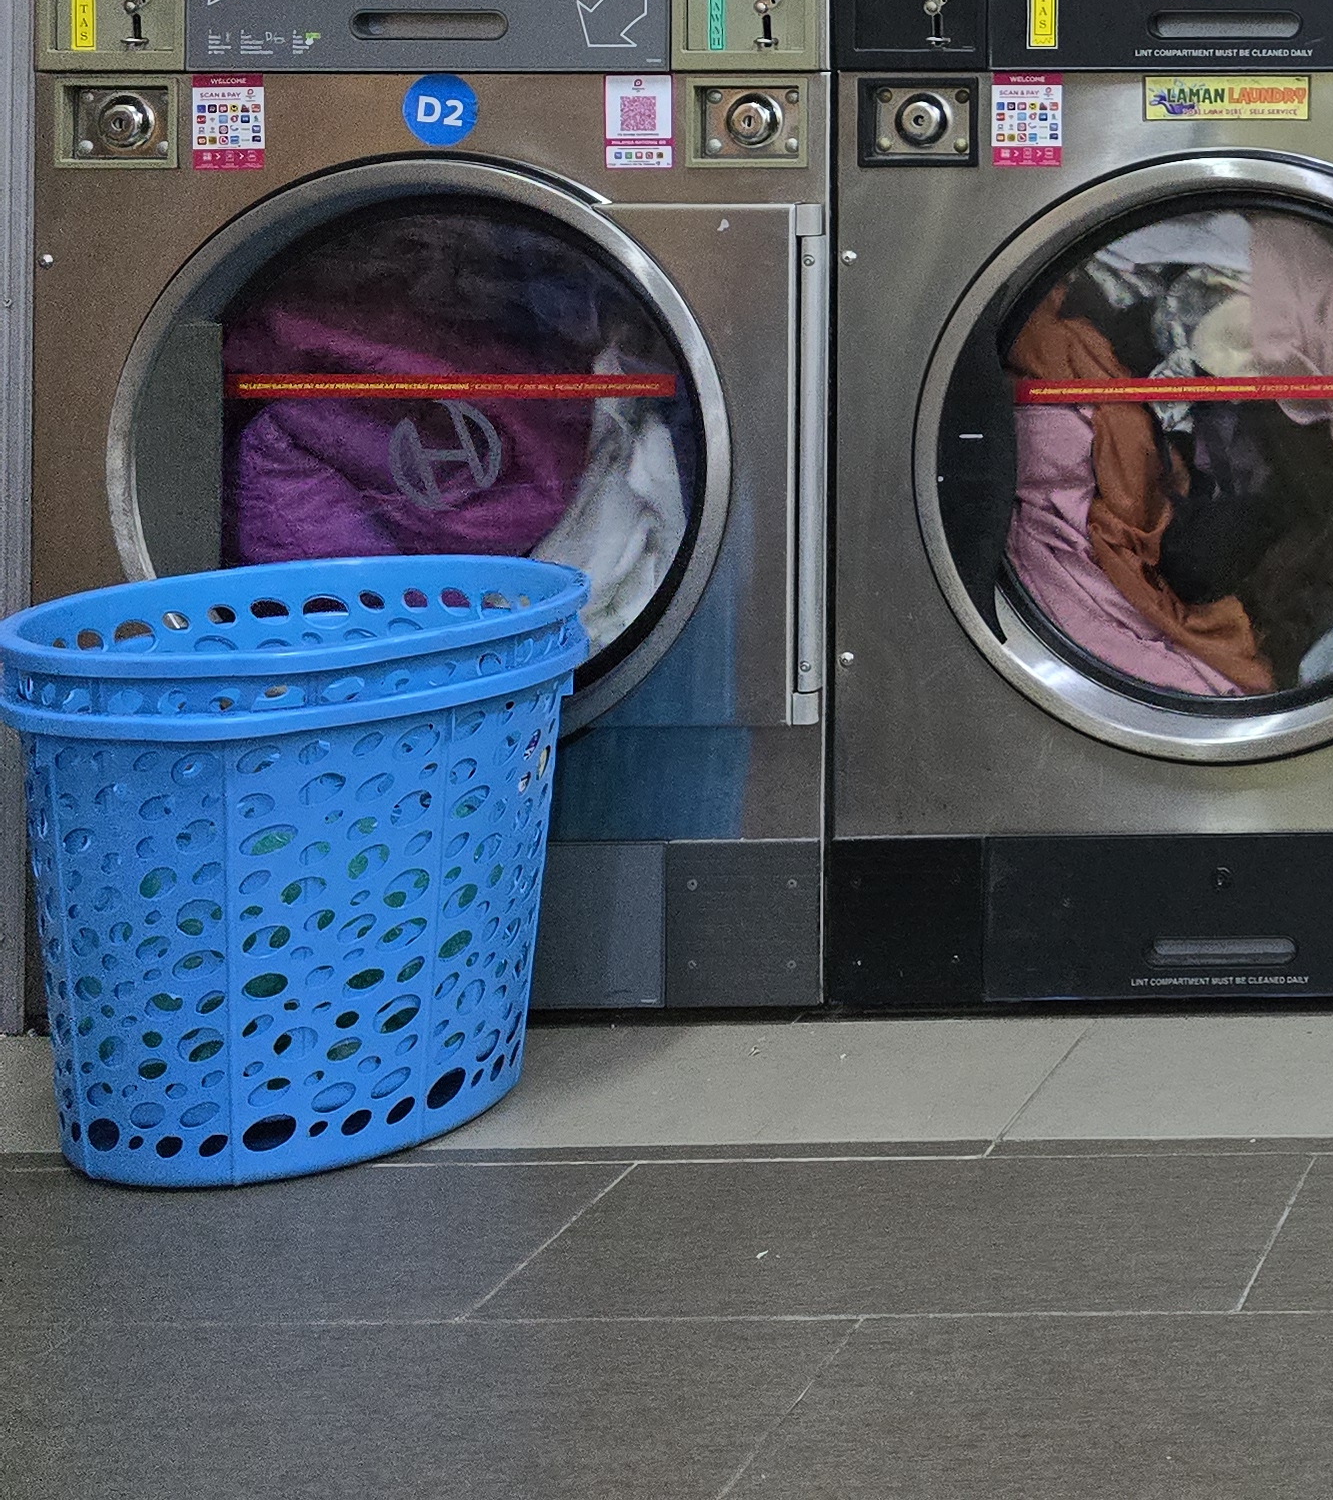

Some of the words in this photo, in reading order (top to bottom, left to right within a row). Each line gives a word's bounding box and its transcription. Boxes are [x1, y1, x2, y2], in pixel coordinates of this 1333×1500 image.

[1134, 48, 1153, 57] LINT
[1154, 48, 1214, 57] COMPARTMENT
[1215, 48, 1238, 57] MUST
[1239, 48, 1250, 57] BE
[1251, 48, 1289, 57] CLEANED
[1290, 48, 1313, 57] DAILY
[1167, 87, 1226, 105] LAMAN
[1228, 86, 1307, 105] LAUNDRY
[418, 96, 464, 127] D2
